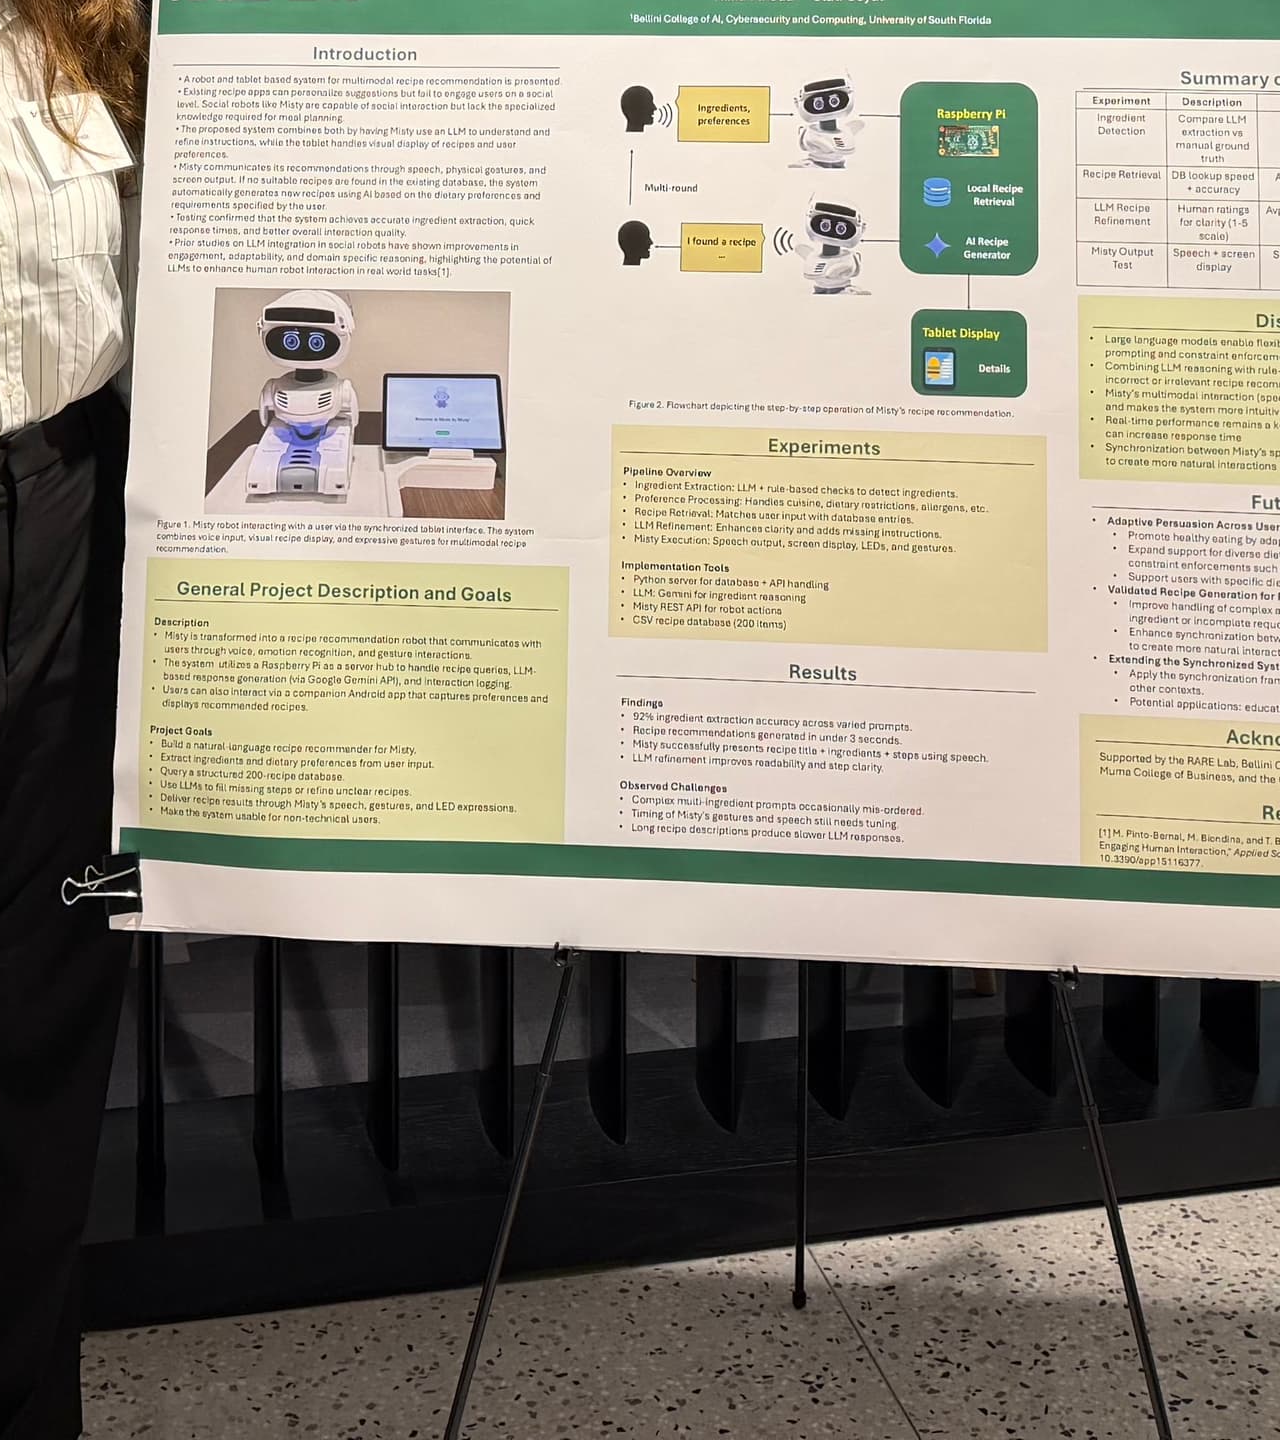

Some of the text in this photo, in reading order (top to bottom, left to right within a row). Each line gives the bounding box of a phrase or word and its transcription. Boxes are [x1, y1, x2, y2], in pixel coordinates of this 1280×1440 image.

[663, 13, 698, 25] College
[700, 14, 710, 23] of
[725, 13, 790, 25] Cybersecurity
[791, 14, 810, 24] and
[868, 15, 916, 26] University
[916, 15, 927, 24] of
[928, 15, 956, 24] South
[958, 15, 991, 24] Florida
[313, 46, 416, 61] Introduction
[1180, 70, 1269, 89] Summary
[1092, 96, 1150, 106] Experiment
[1182, 96, 1242, 108] Description
[937, 108, 1006, 121] Raspberry Pi
[1097, 113, 1146, 124] Ingredient
[1177, 114, 1246, 125] Compare LLM
[697, 116, 750, 126] preferences
[1097, 125, 1145, 135] Detection
[1181, 128, 1230, 136] extraction
[1175, 140, 1249, 152] manual ground
[1200, 154, 1224, 163] truth
[1082, 168, 1161, 180] Recipe Retrieval
[1171, 170, 1254, 182] DB lookup speed
[644, 183, 697, 192] Multi-round
[967, 183, 1023, 195] Local Recipe
[1195, 186, 1240, 196] accuracy
[973, 196, 1014, 206] Retrieval
[1094, 202, 1150, 214] LLM Recipe
[1177, 204, 1249, 216] Human ratings
[1094, 215, 1150, 226] Refinement
[1179, 217, 1248, 229] for clarity (1-5
[692, 236, 719, 245] found
[729, 237, 756, 248] recipe
[965, 236, 1009, 248] AI Recipe
[963, 249, 1011, 259] Generator
[1091, 246, 1154, 258] Misty Output
[1172, 247, 1210, 258] Speech
[1221, 250, 1255, 259] screen
[1112, 260, 1132, 269] Test
[1196, 261, 1232, 273] display
[922, 327, 1000, 341] Tablet Display
[978, 363, 1011, 373] Details
[768, 438, 881, 457] Experiments
[623, 466, 711, 477] Pipeline Overview
[621, 560, 729, 572] Implementation Tools
[176, 581, 511, 602] General Project Description and Goals
[154, 616, 209, 628] Description
[789, 663, 856, 681] Results
[621, 697, 663, 709] Findings
[149, 724, 212, 736] Project Goals
[159, 766, 188, 778] Query
[196, 768, 244, 779] structured
[245, 770, 296, 782] 200-recipe
[619, 780, 727, 795] Observed Challenges
